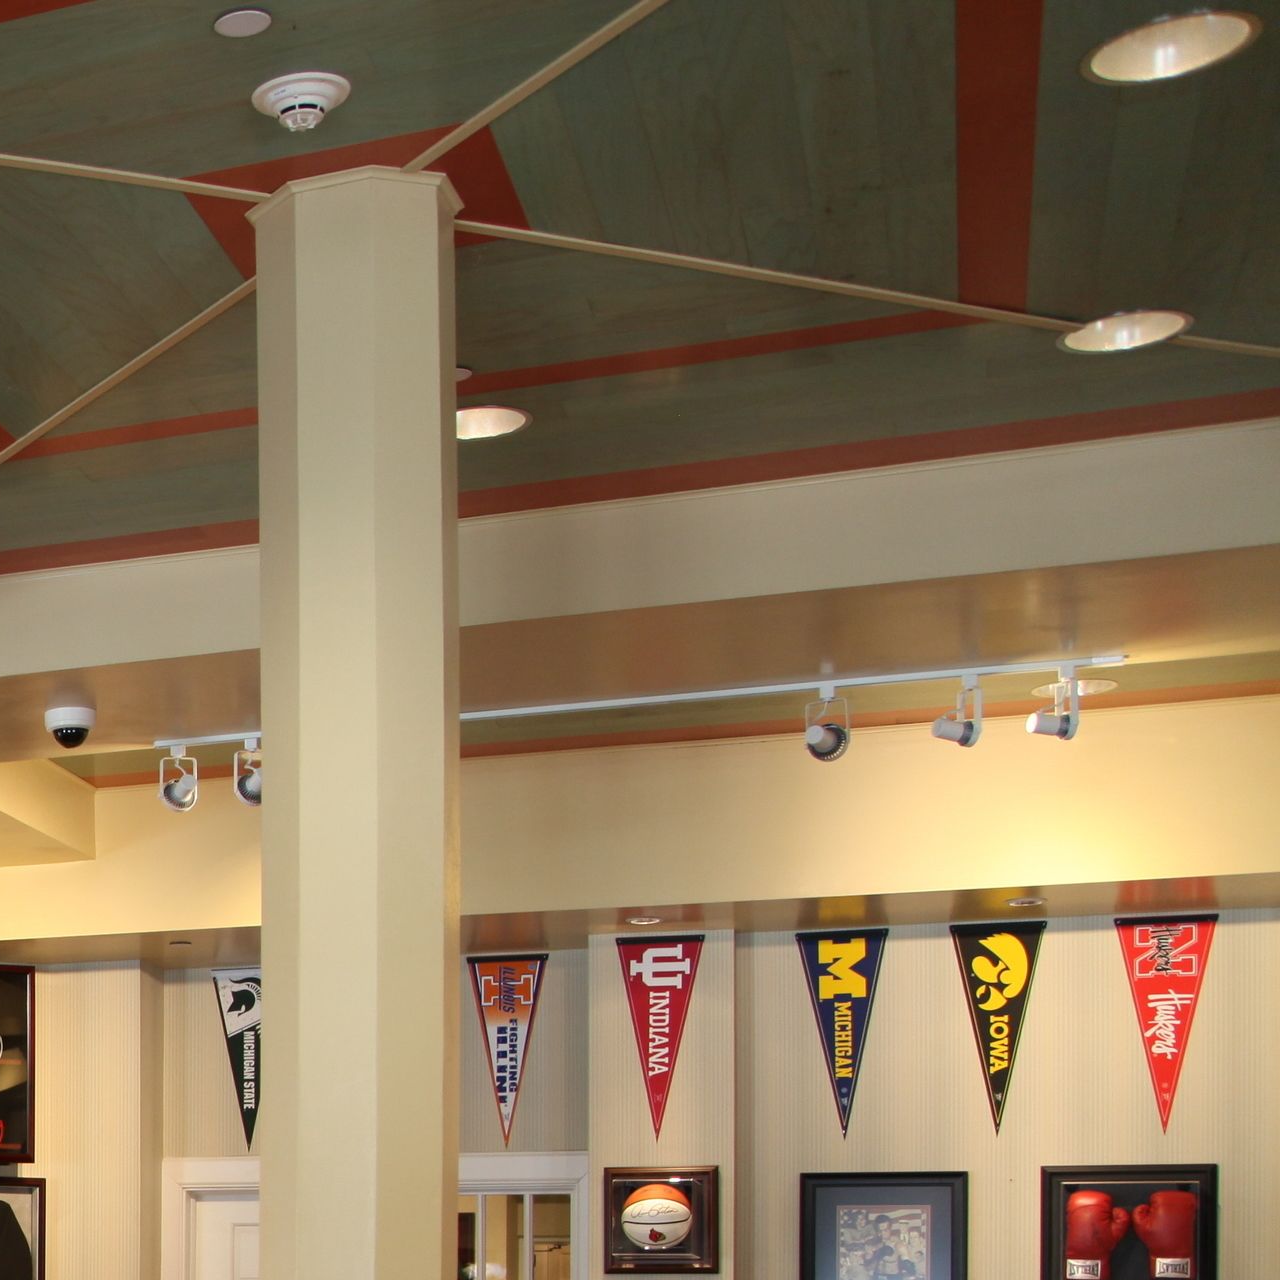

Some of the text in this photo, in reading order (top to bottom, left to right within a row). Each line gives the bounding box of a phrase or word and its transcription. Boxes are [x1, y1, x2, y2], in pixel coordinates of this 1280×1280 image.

[818, 937, 867, 1000] M
[508, 1018, 518, 1093] FIGHTING
[648, 991, 670, 1077] INDIANA
[834, 1001, 853, 1079] MICHIGAN
[989, 1014, 1009, 1074] IOWA
[1144, 988, 1194, 1060] Huskers
[243, 1031, 255, 1110] MICHIGAN STATE
[496, 1025, 508, 1105] ILLINI
